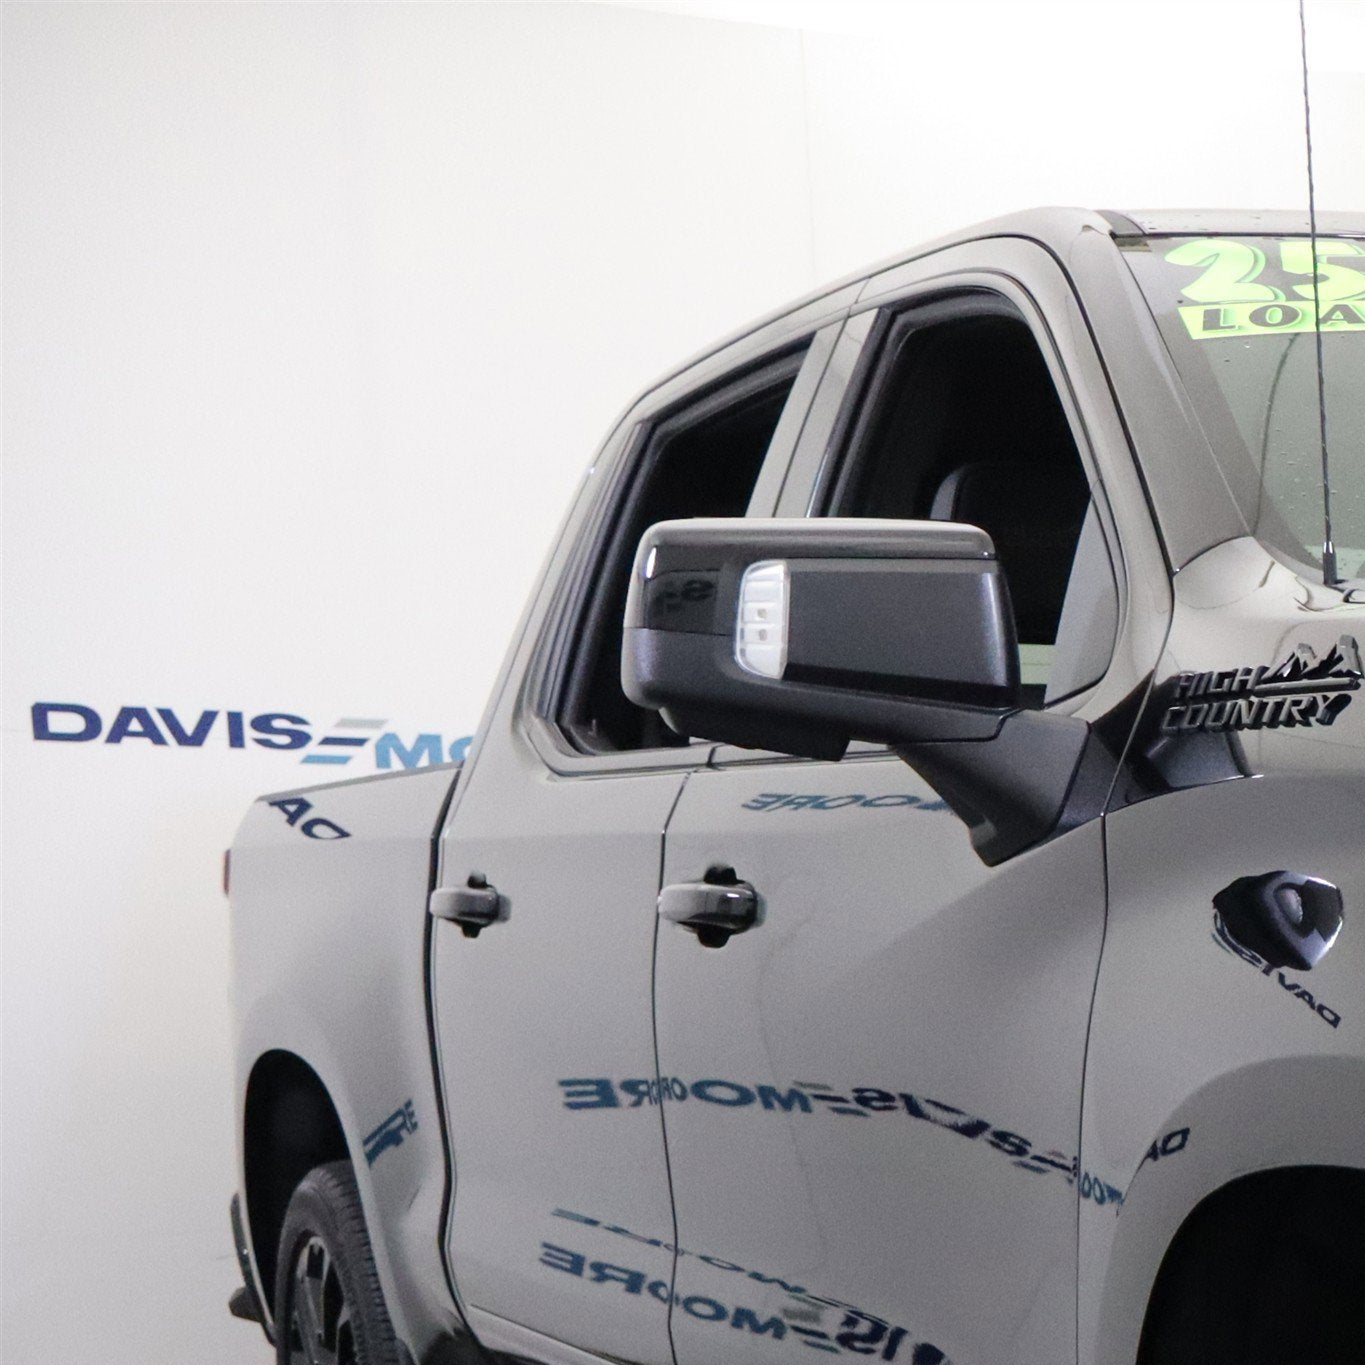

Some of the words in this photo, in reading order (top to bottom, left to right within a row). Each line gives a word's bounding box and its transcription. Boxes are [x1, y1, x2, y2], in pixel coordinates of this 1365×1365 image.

[1173, 664, 1268, 699] HIGH
[30, 701, 314, 751] DAVIS
[1161, 692, 1353, 731] COUNTRY
